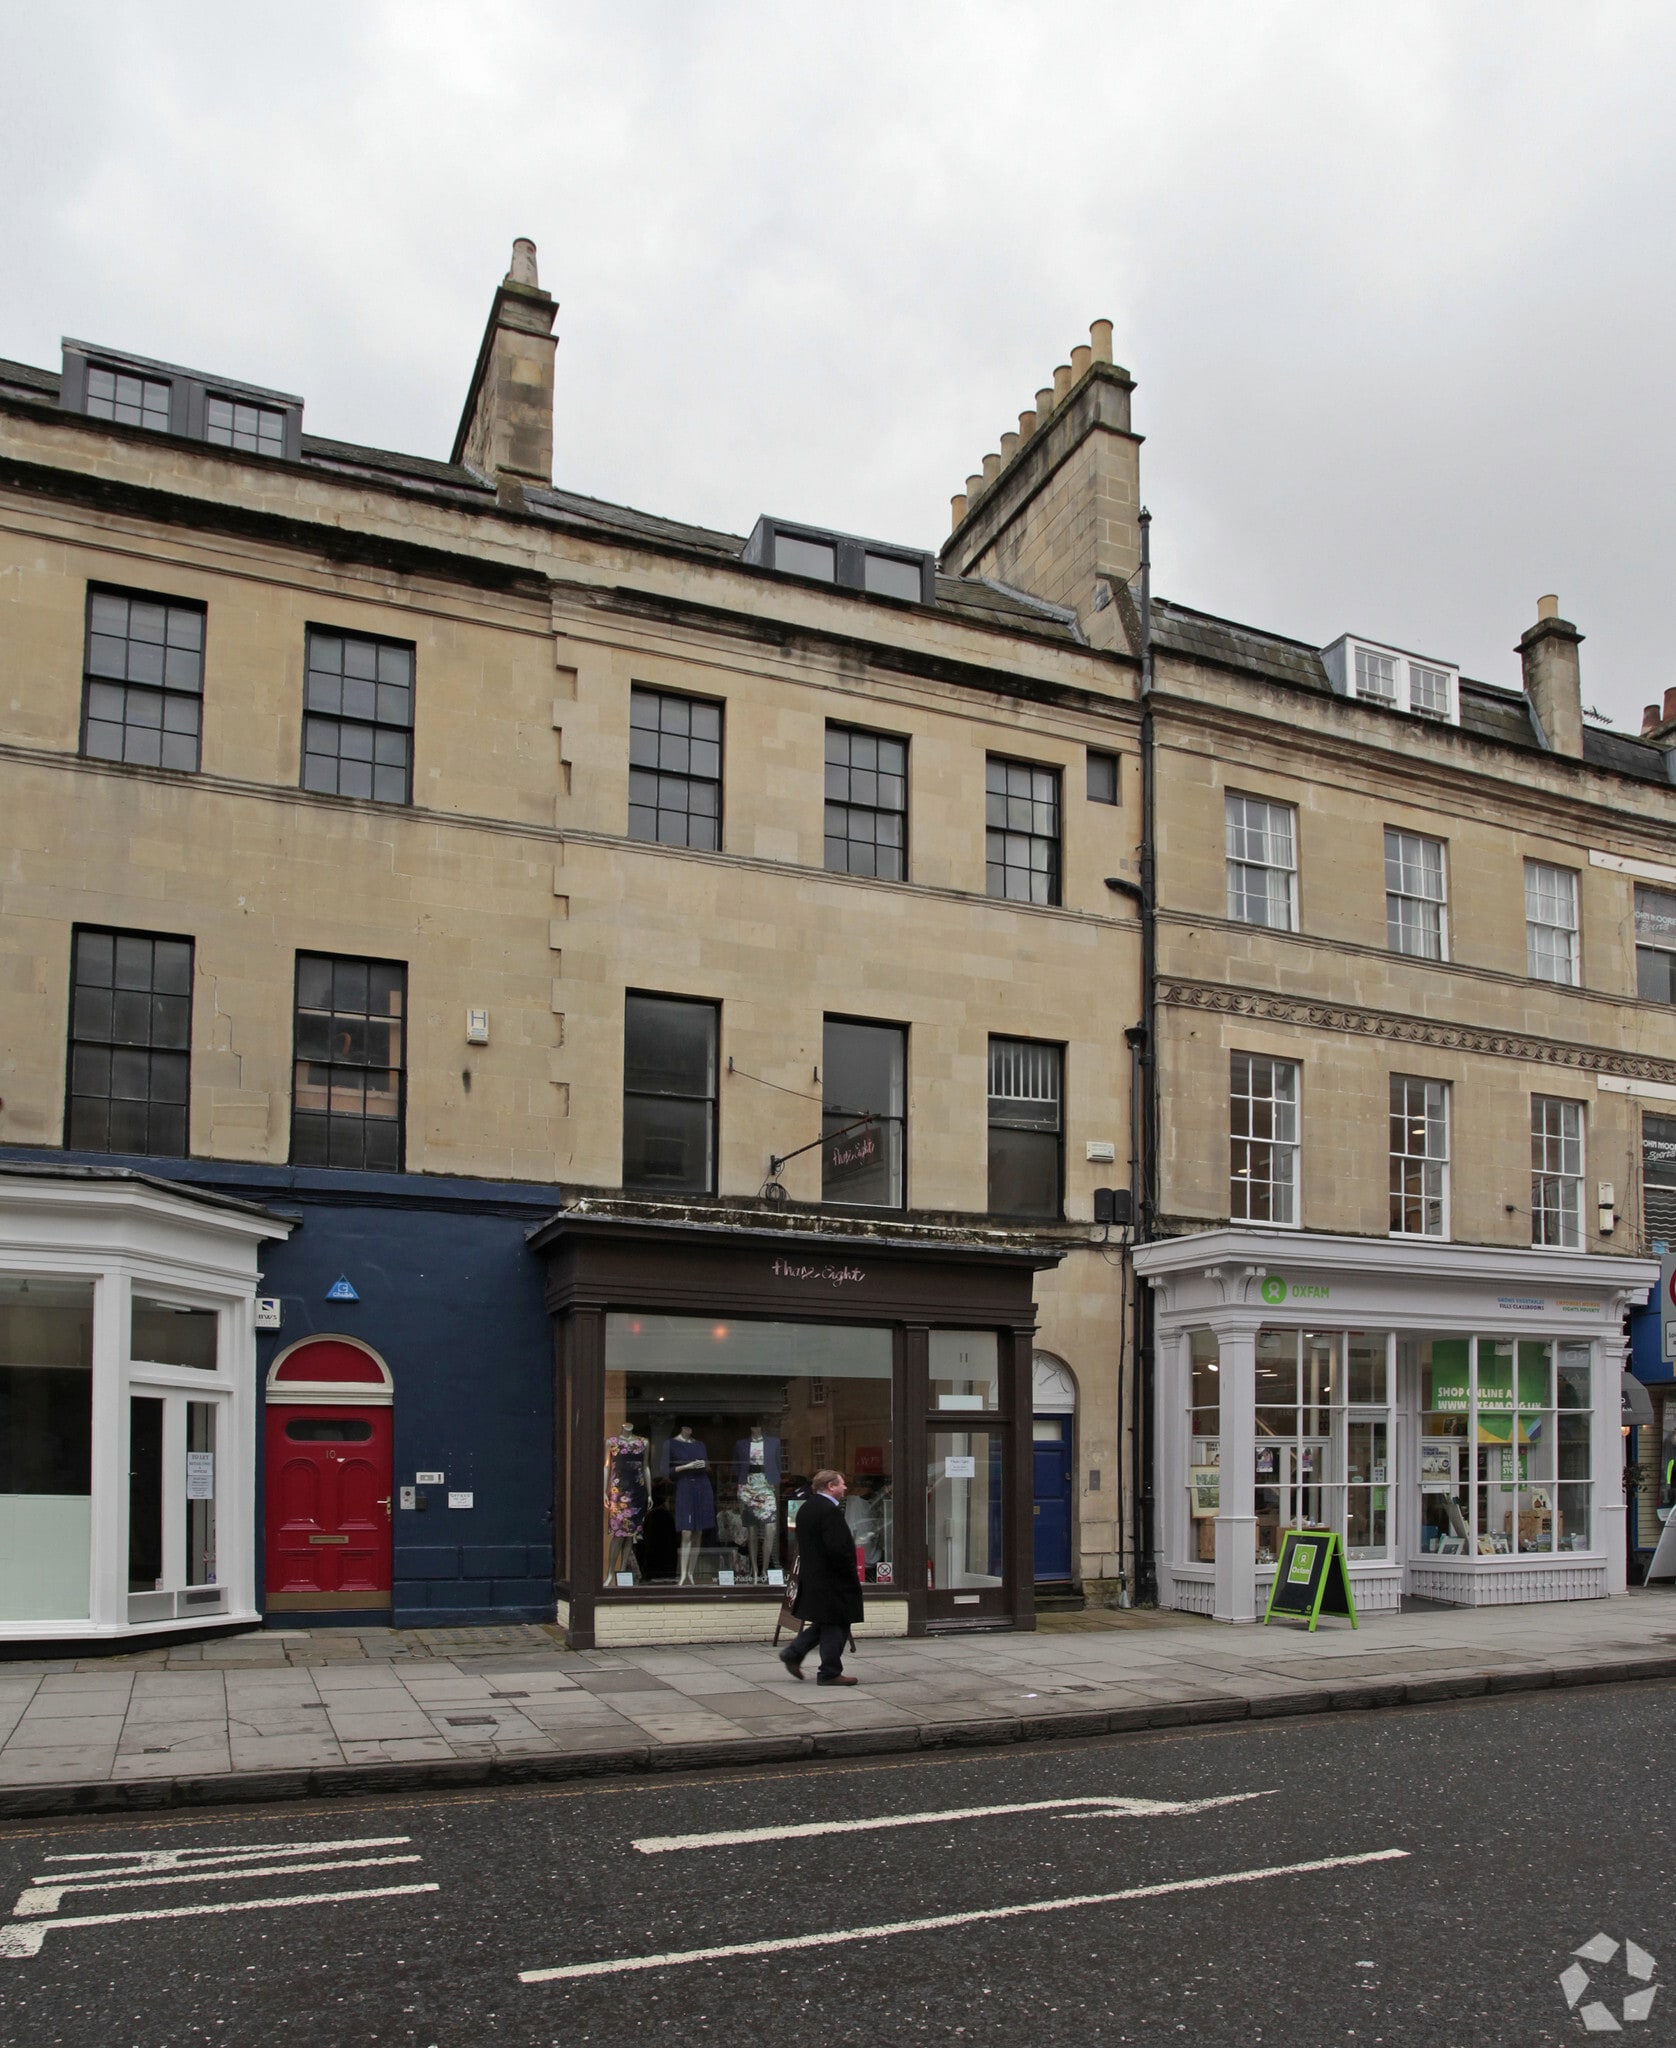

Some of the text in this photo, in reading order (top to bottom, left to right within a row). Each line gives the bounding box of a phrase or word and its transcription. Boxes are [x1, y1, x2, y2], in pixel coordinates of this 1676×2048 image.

[1635, 911, 1650, 921] OHN
[1642, 1139, 1657, 1149] OHN
[1292, 1284, 1330, 1298] OXFAM
[1438, 1387, 1464, 1397] SHOP
